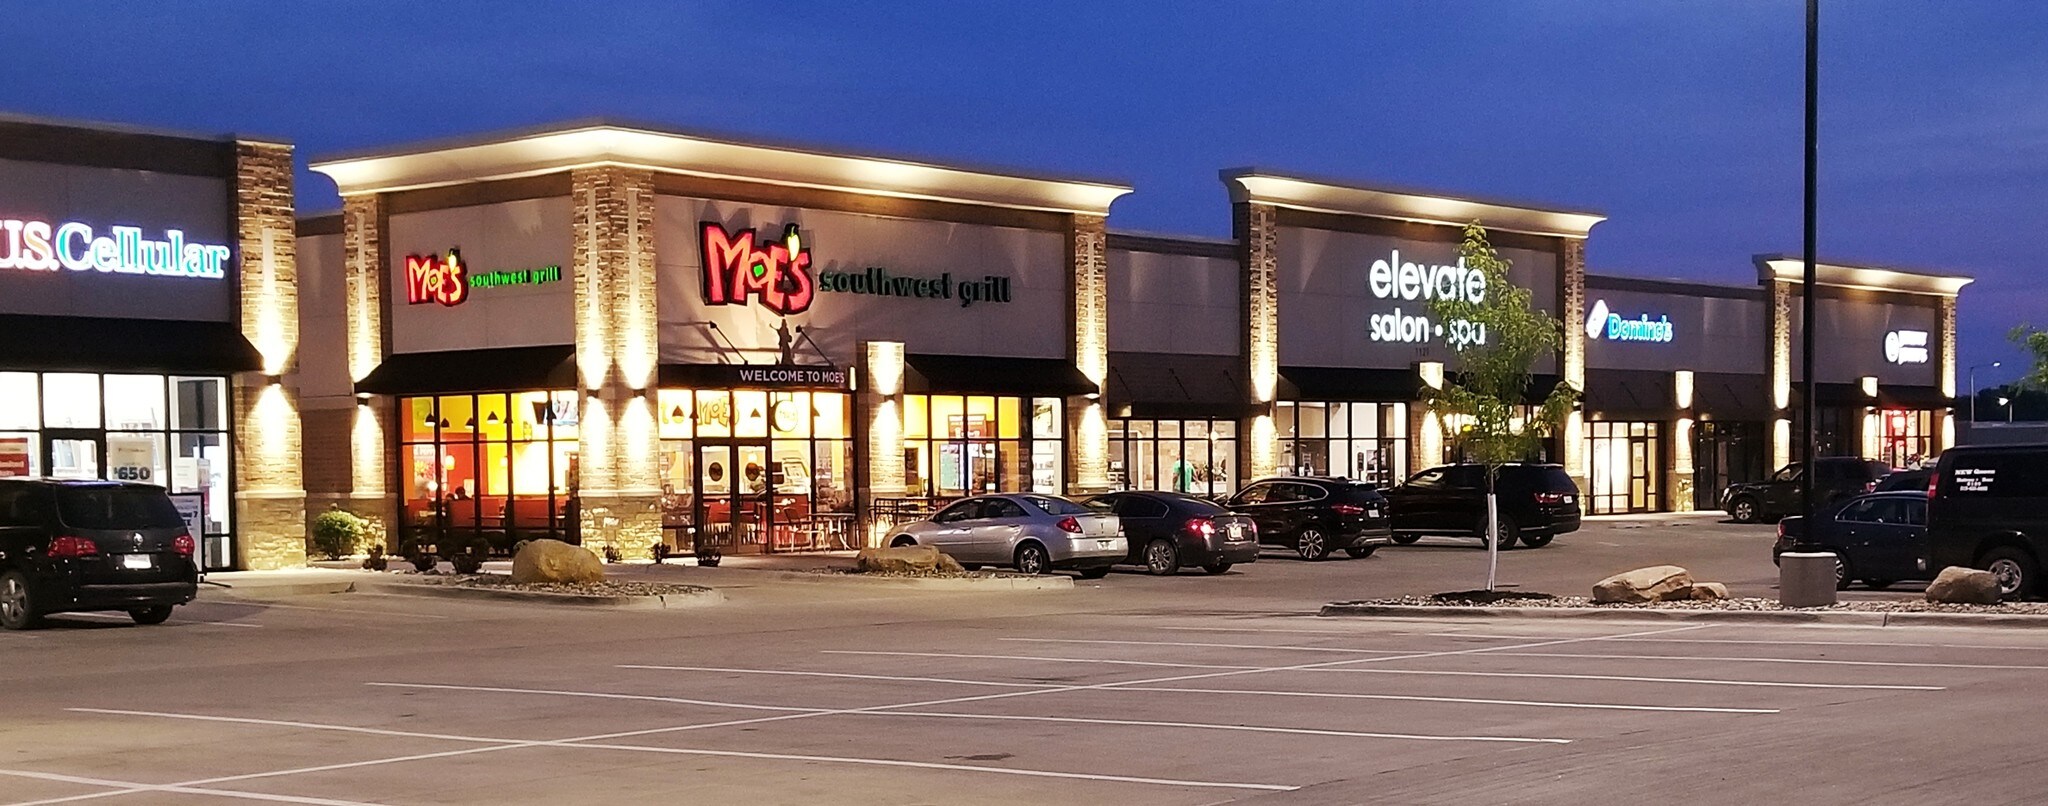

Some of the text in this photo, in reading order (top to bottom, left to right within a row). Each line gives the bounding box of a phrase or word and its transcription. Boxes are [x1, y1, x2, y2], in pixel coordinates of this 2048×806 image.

[56, 222, 230, 278] Cellular
[470, 270, 528, 288] southwest
[533, 266, 560, 284] grill
[819, 266, 952, 299] southwest
[958, 275, 1012, 307] grill
[1370, 249, 1486, 304] elevate
[1370, 307, 1486, 351] salon spa
[1608, 313, 1673, 342] Domino's
[739, 369, 845, 383] WELCOME TO MOE'S
